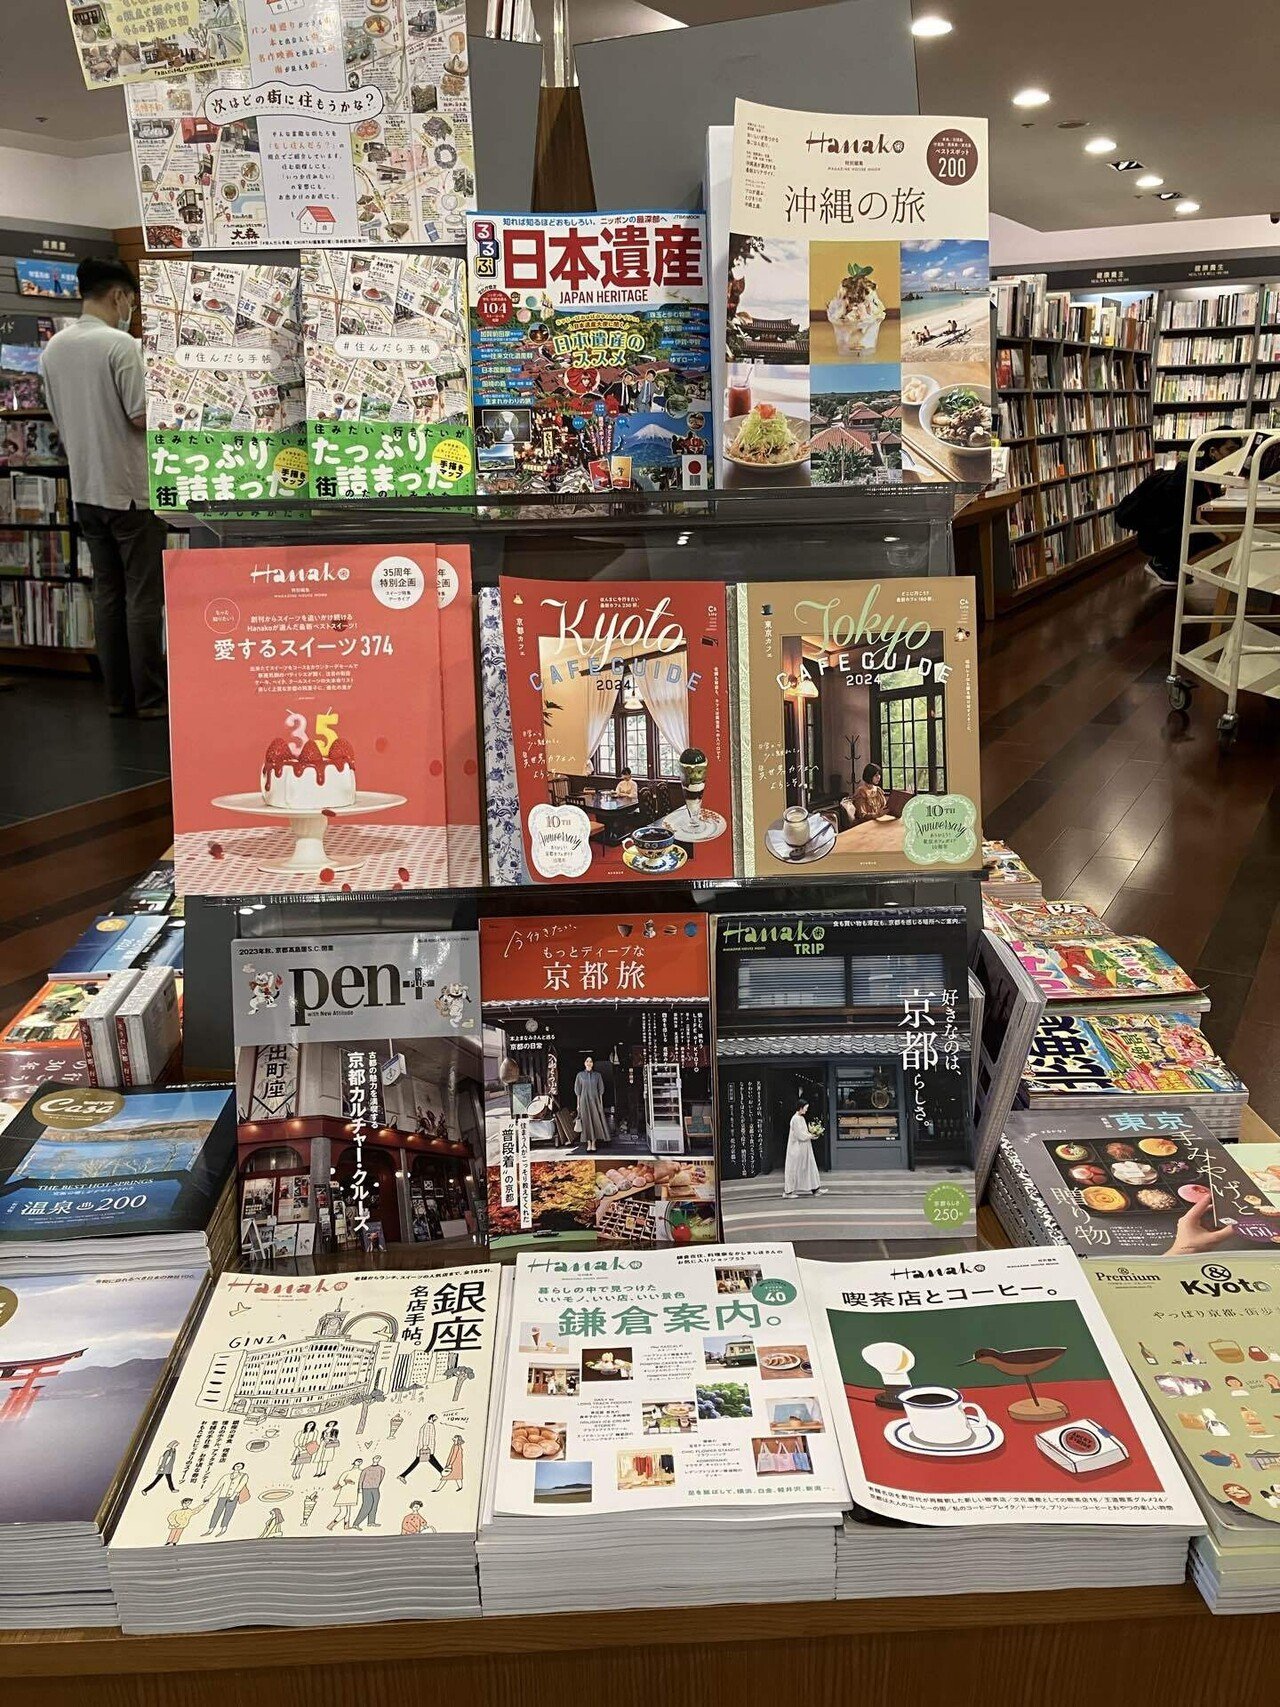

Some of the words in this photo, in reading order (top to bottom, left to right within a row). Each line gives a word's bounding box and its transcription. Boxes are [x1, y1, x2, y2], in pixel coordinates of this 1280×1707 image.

[938, 157, 966, 178] 200
[785, 185, 927, 225] 沖縄の旅
[475, 222, 499, 276] るるぶ
[503, 224, 703, 290] 日本遺産
[559, 291, 593, 304] JAPAN
[597, 288, 648, 303] HERITAGE
[483, 302, 507, 314] 104
[343, 340, 432, 355] #住んだら手帳
[184, 351, 273, 365] #住んだら手帳
[250, 562, 350, 584] Hanako
[383, 567, 411, 577] 35周年
[380, 578, 416, 588] 特別企画
[540, 597, 687, 672] Kyoto
[794, 584, 930, 669] Tokyo
[515, 617, 526, 656] 京都カフェ
[764, 619, 773, 658] 東京カフェ
[597, 679, 632, 690] 2024
[846, 674, 881, 687] 2024
[723, 921, 825, 944] Hanako
[542, 944, 645, 959] もっとディープな
[794, 943, 825, 955] TRIP
[542, 961, 646, 991] 京都旅
[510, 1042, 543, 1051] 京都の日常
[1109, 1112, 1193, 1131] 東京
[21, 1201, 74, 1215] 温泉
[94, 1194, 148, 1211] 200
[934, 1208, 959, 1220] 250
[1051, 1186, 1111, 1245] 贈り物
[527, 1256, 643, 1273] Hanako
[890, 1261, 986, 1280] Hanako
[228, 1277, 348, 1294] Hanako
[1096, 1272, 1161, 1281] Premium
[538, 1284, 657, 1295] 暮らしの中で見つけた
[765, 1292, 786, 1302] 40
[841, 1284, 1058, 1308] 喫茶店とコーヒー。
[1180, 1278, 1272, 1297] Kyoto
[402, 1286, 429, 1346] 名店手帖。
[425, 1281, 487, 1352] 銀座
[558, 1299, 782, 1338] 鎌倉案内。
[228, 1333, 288, 1349] GINZA
